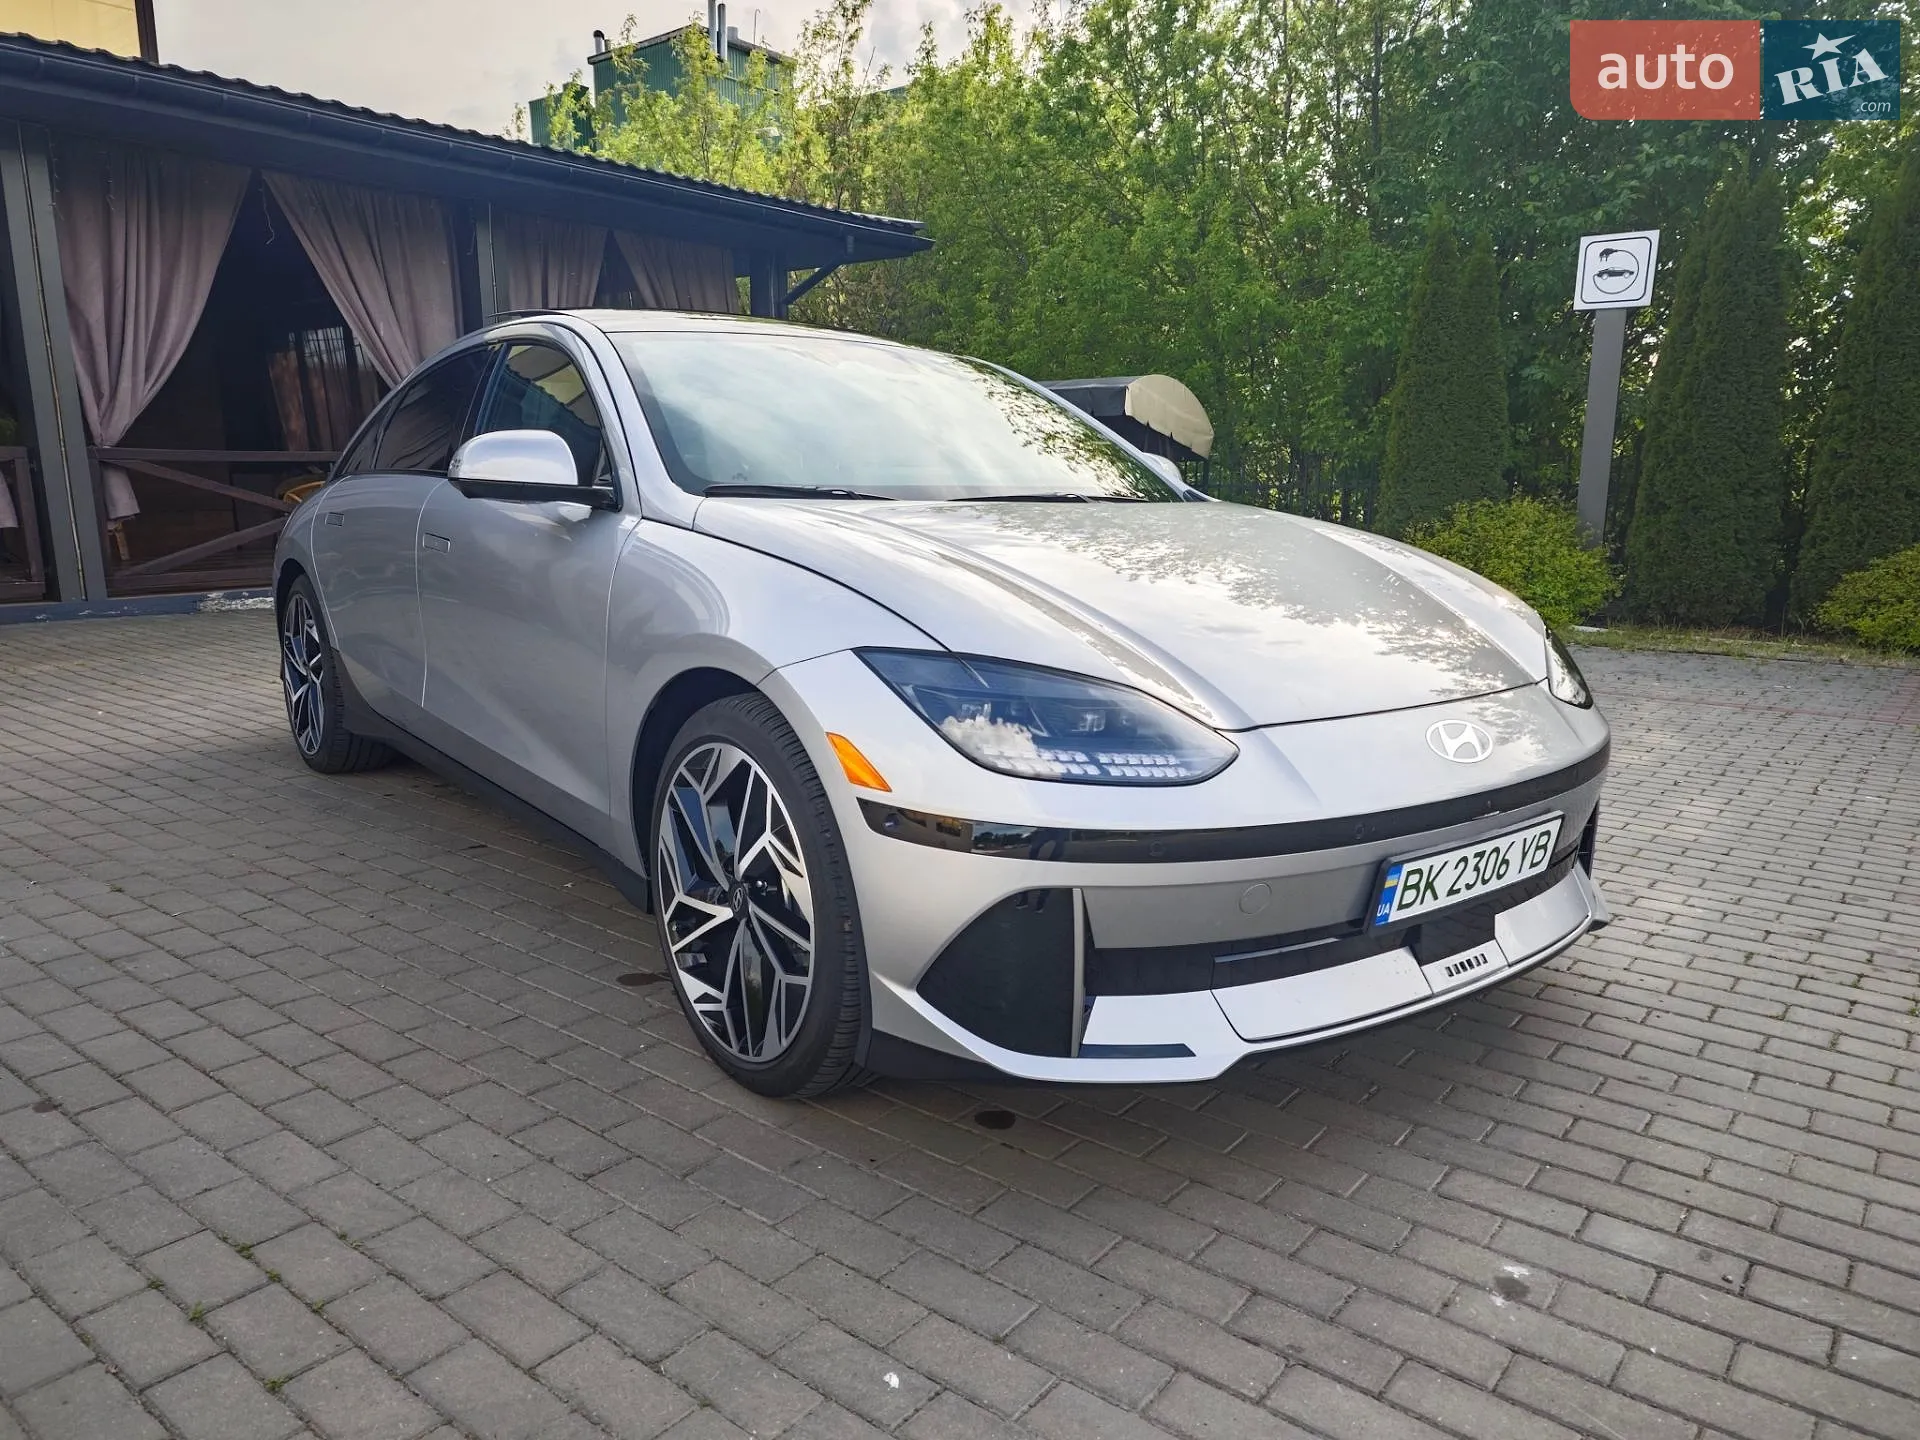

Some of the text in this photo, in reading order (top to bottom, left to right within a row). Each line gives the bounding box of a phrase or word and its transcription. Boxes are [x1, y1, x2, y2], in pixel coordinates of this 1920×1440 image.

[1397, 830, 1551, 911] BK 2306 YB
[1376, 904, 1390, 917] UA
